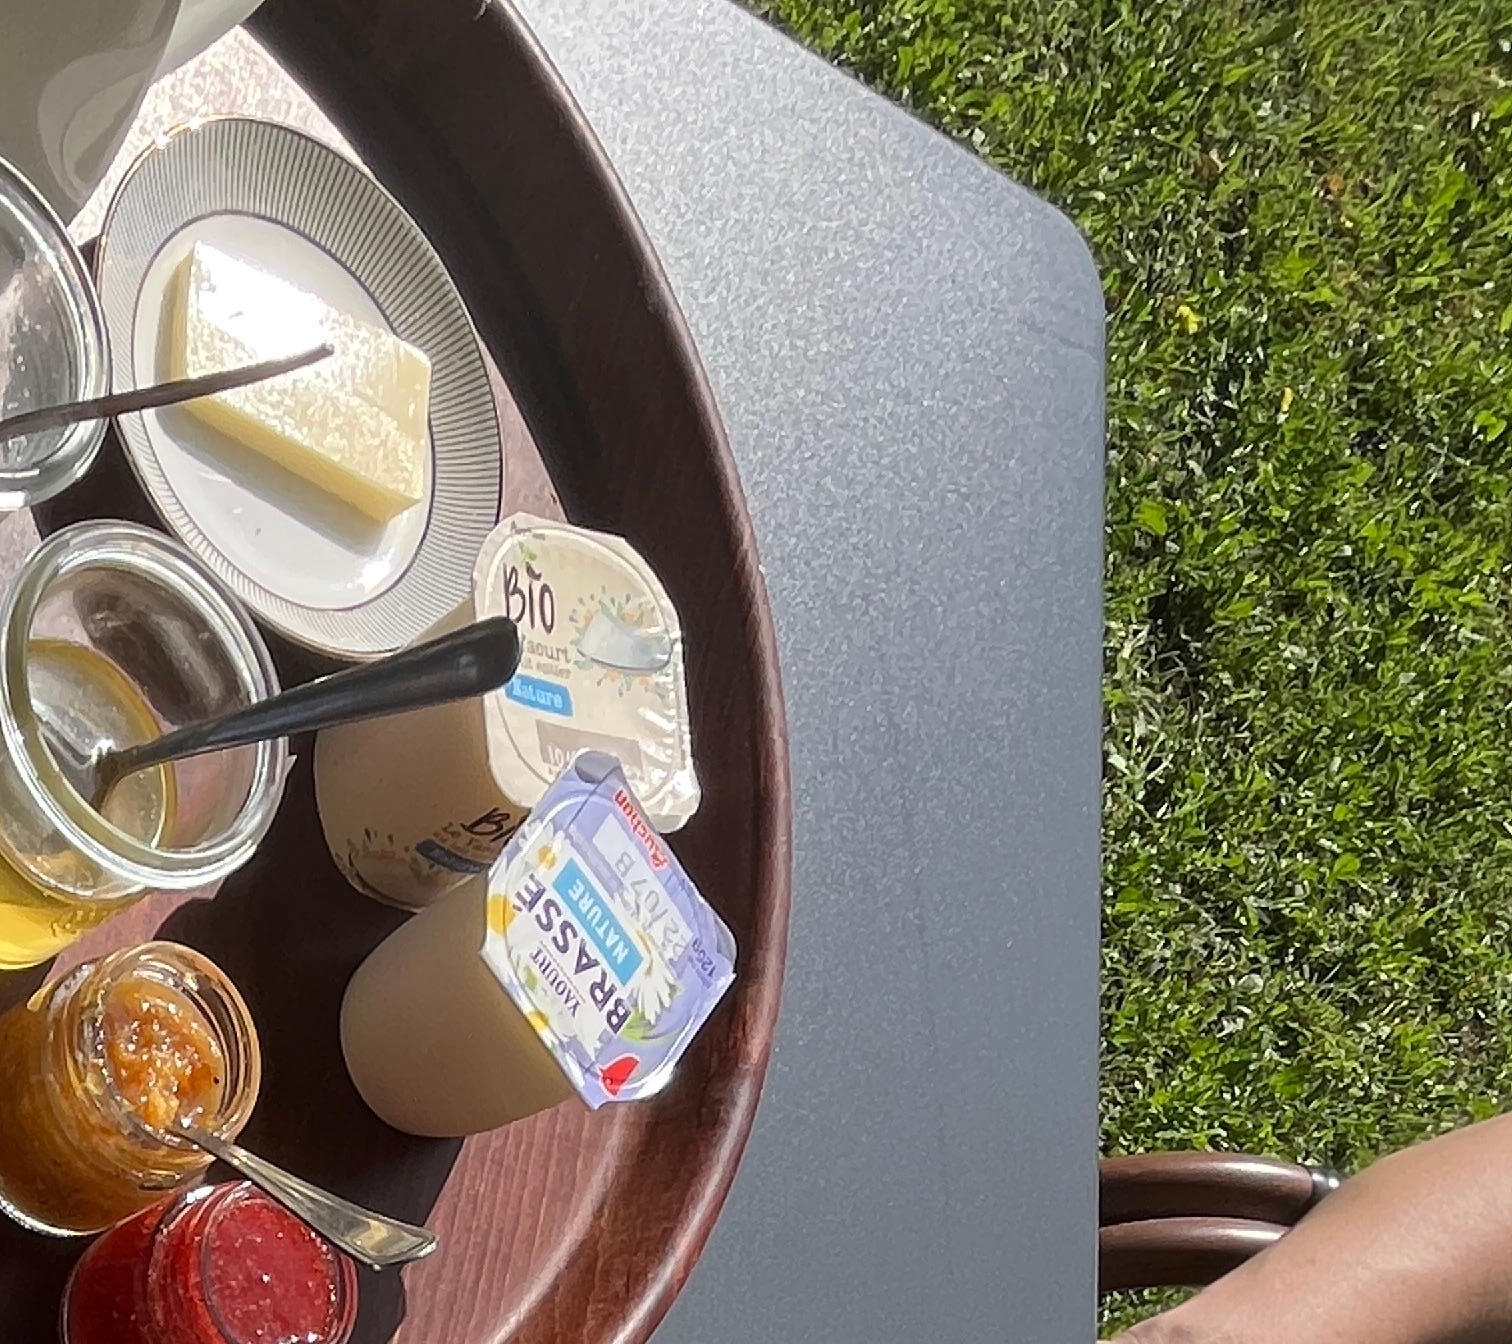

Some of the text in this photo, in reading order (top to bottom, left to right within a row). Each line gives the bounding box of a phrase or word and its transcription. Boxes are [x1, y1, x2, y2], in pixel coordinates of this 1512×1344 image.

[614, 789, 668, 868] Auchan
[512, 873, 631, 1034] BRASSÉ
[568, 878, 629, 965] NATURE
[529, 948, 581, 1018] YAOURT
